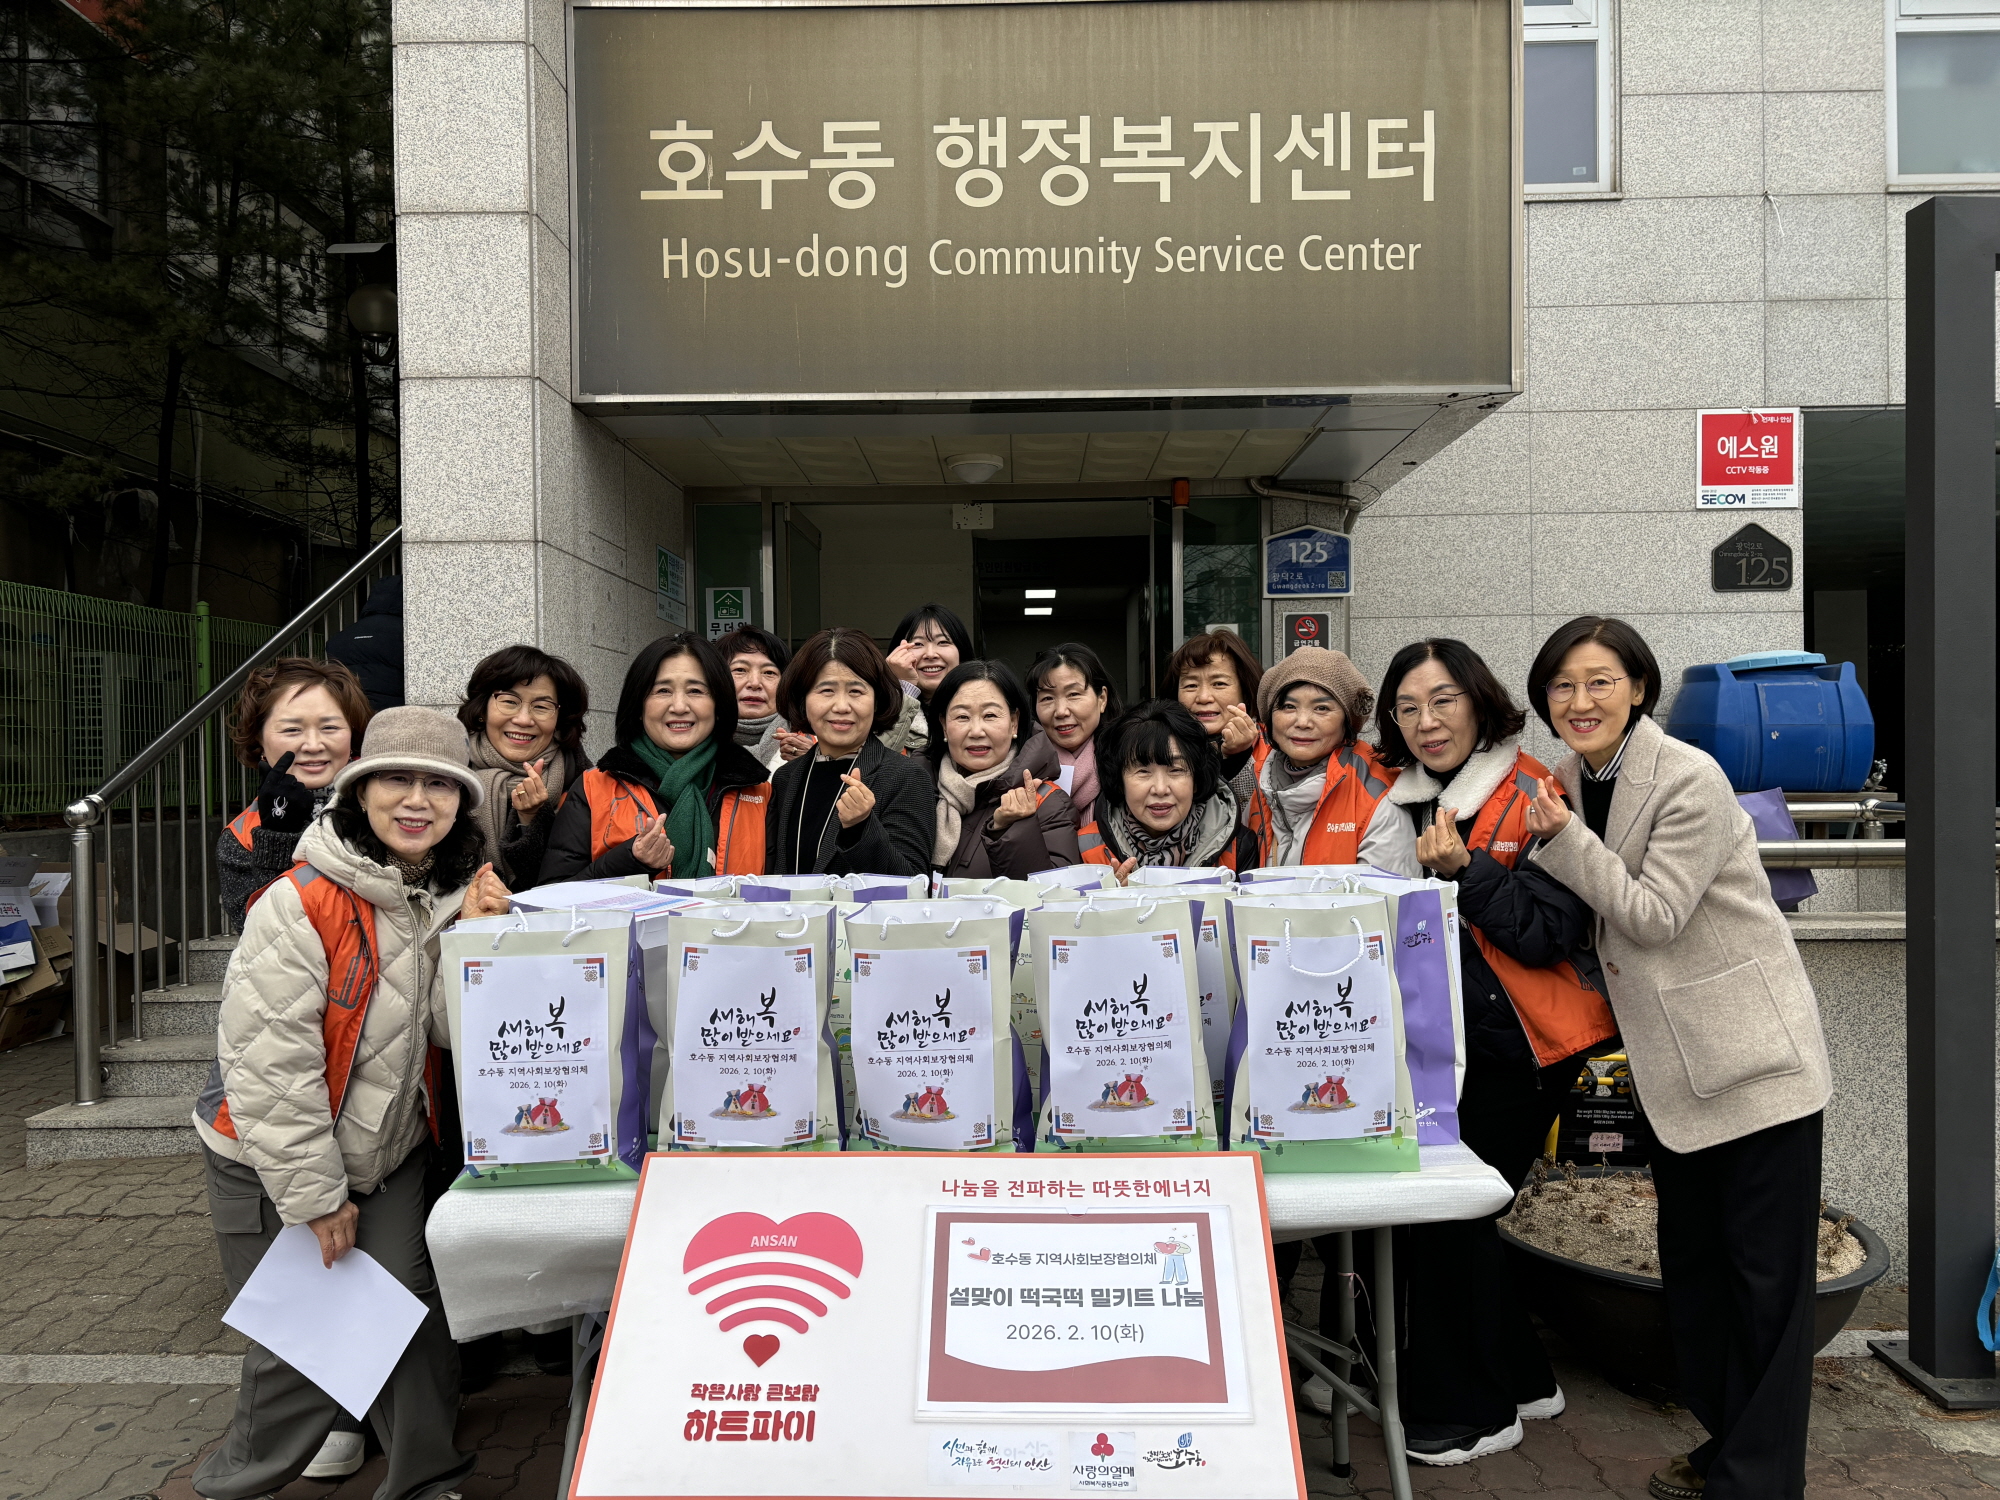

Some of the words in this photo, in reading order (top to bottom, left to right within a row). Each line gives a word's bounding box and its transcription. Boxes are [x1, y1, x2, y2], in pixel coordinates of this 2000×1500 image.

[640, 118, 895, 210] 호수동
[933, 109, 1435, 208] 행정복지센터
[662, 233, 908, 289] Hosu-dong
[929, 236, 1142, 284] Community
[1154, 234, 1285, 273] Service
[1298, 234, 1422, 273] Center
[1717, 435, 1779, 459] 에스원
[1725, 466, 1747, 474] CCTV
[1748, 466, 1769, 474] 작동중
[1701, 494, 1746, 505] SECOM
[1288, 541, 1329, 564] 125
[1272, 571, 1304, 582] 광덕2로
[1735, 556, 1789, 586] 125
[1083, 998, 1130, 1017] 새해
[1130, 973, 1150, 1016] 복
[1285, 999, 1333, 1018] 새해
[1333, 976, 1354, 1018] 복
[709, 1006, 756, 1026] 새해
[756, 986, 778, 1028] 복
[885, 1010, 932, 1029] 새해
[932, 987, 952, 1029] 복
[498, 1019, 544, 1039] 새해
[545, 996, 567, 1038] 복
[1065, 1045, 1092, 1056] 호수동
[1094, 1041, 1172, 1055] 지역사회보장협의체
[1265, 1046, 1292, 1057] 호수동
[1295, 1043, 1375, 1056] 지역사회보장협의체
[688, 1052, 715, 1063] 호수동
[718, 1052, 797, 1063] 지역사회보장협의체
[867, 1055, 893, 1066] 호수동
[895, 1053, 974, 1065] 지역사회보장협의체
[1096, 1058, 1117, 1067] 2026.
[1129, 1056, 1153, 1066] 10(화)
[1296, 1060, 1318, 1068] 2026.
[1330, 1058, 1355, 1068] 10(화)
[477, 1066, 505, 1078] 호수동
[508, 1065, 588, 1077] 지역사회보장협의체
[719, 1067, 741, 1075] 2026.
[753, 1066, 777, 1076] 10(화)
[897, 1070, 918, 1078] 2026.
[930, 1068, 954, 1078] 10(화)
[509, 1081, 532, 1089] 2026.
[544, 1080, 568, 1089] 10(화)
[941, 1179, 1000, 1198] 나눔을
[1007, 1179, 1086, 1198] 전파하는
[1092, 1178, 1212, 1198] 따뜻한에너지
[750, 1235, 799, 1249] ANSAN
[991, 1252, 1032, 1266] 호수동
[1035, 1251, 1158, 1267] 지역사회보장협의체
[949, 1287, 1013, 1308] 설맞이
[1019, 1287, 1084, 1308] 떡국떡
[1090, 1287, 1156, 1308] 밀키트
[1161, 1287, 1204, 1308] 나눔
[1006, 1323, 1061, 1341] 2026.
[1067, 1323, 1085, 1341] 2.
[1090, 1322, 1145, 1344] 10(화)
[690, 1383, 762, 1402] 작은사랑
[766, 1383, 820, 1403] 큰보람
[683, 1409, 816, 1443] 하트파이
[942, 1438, 975, 1458] 시민과
[951, 1456, 983, 1473] 자유로운
[986, 1456, 1022, 1473] 혁신도시
[1024, 1457, 1053, 1471] 안산
[1072, 1465, 1135, 1479] 사랑의열매
[1078, 1480, 1130, 1488] 사회복지공동모금회
